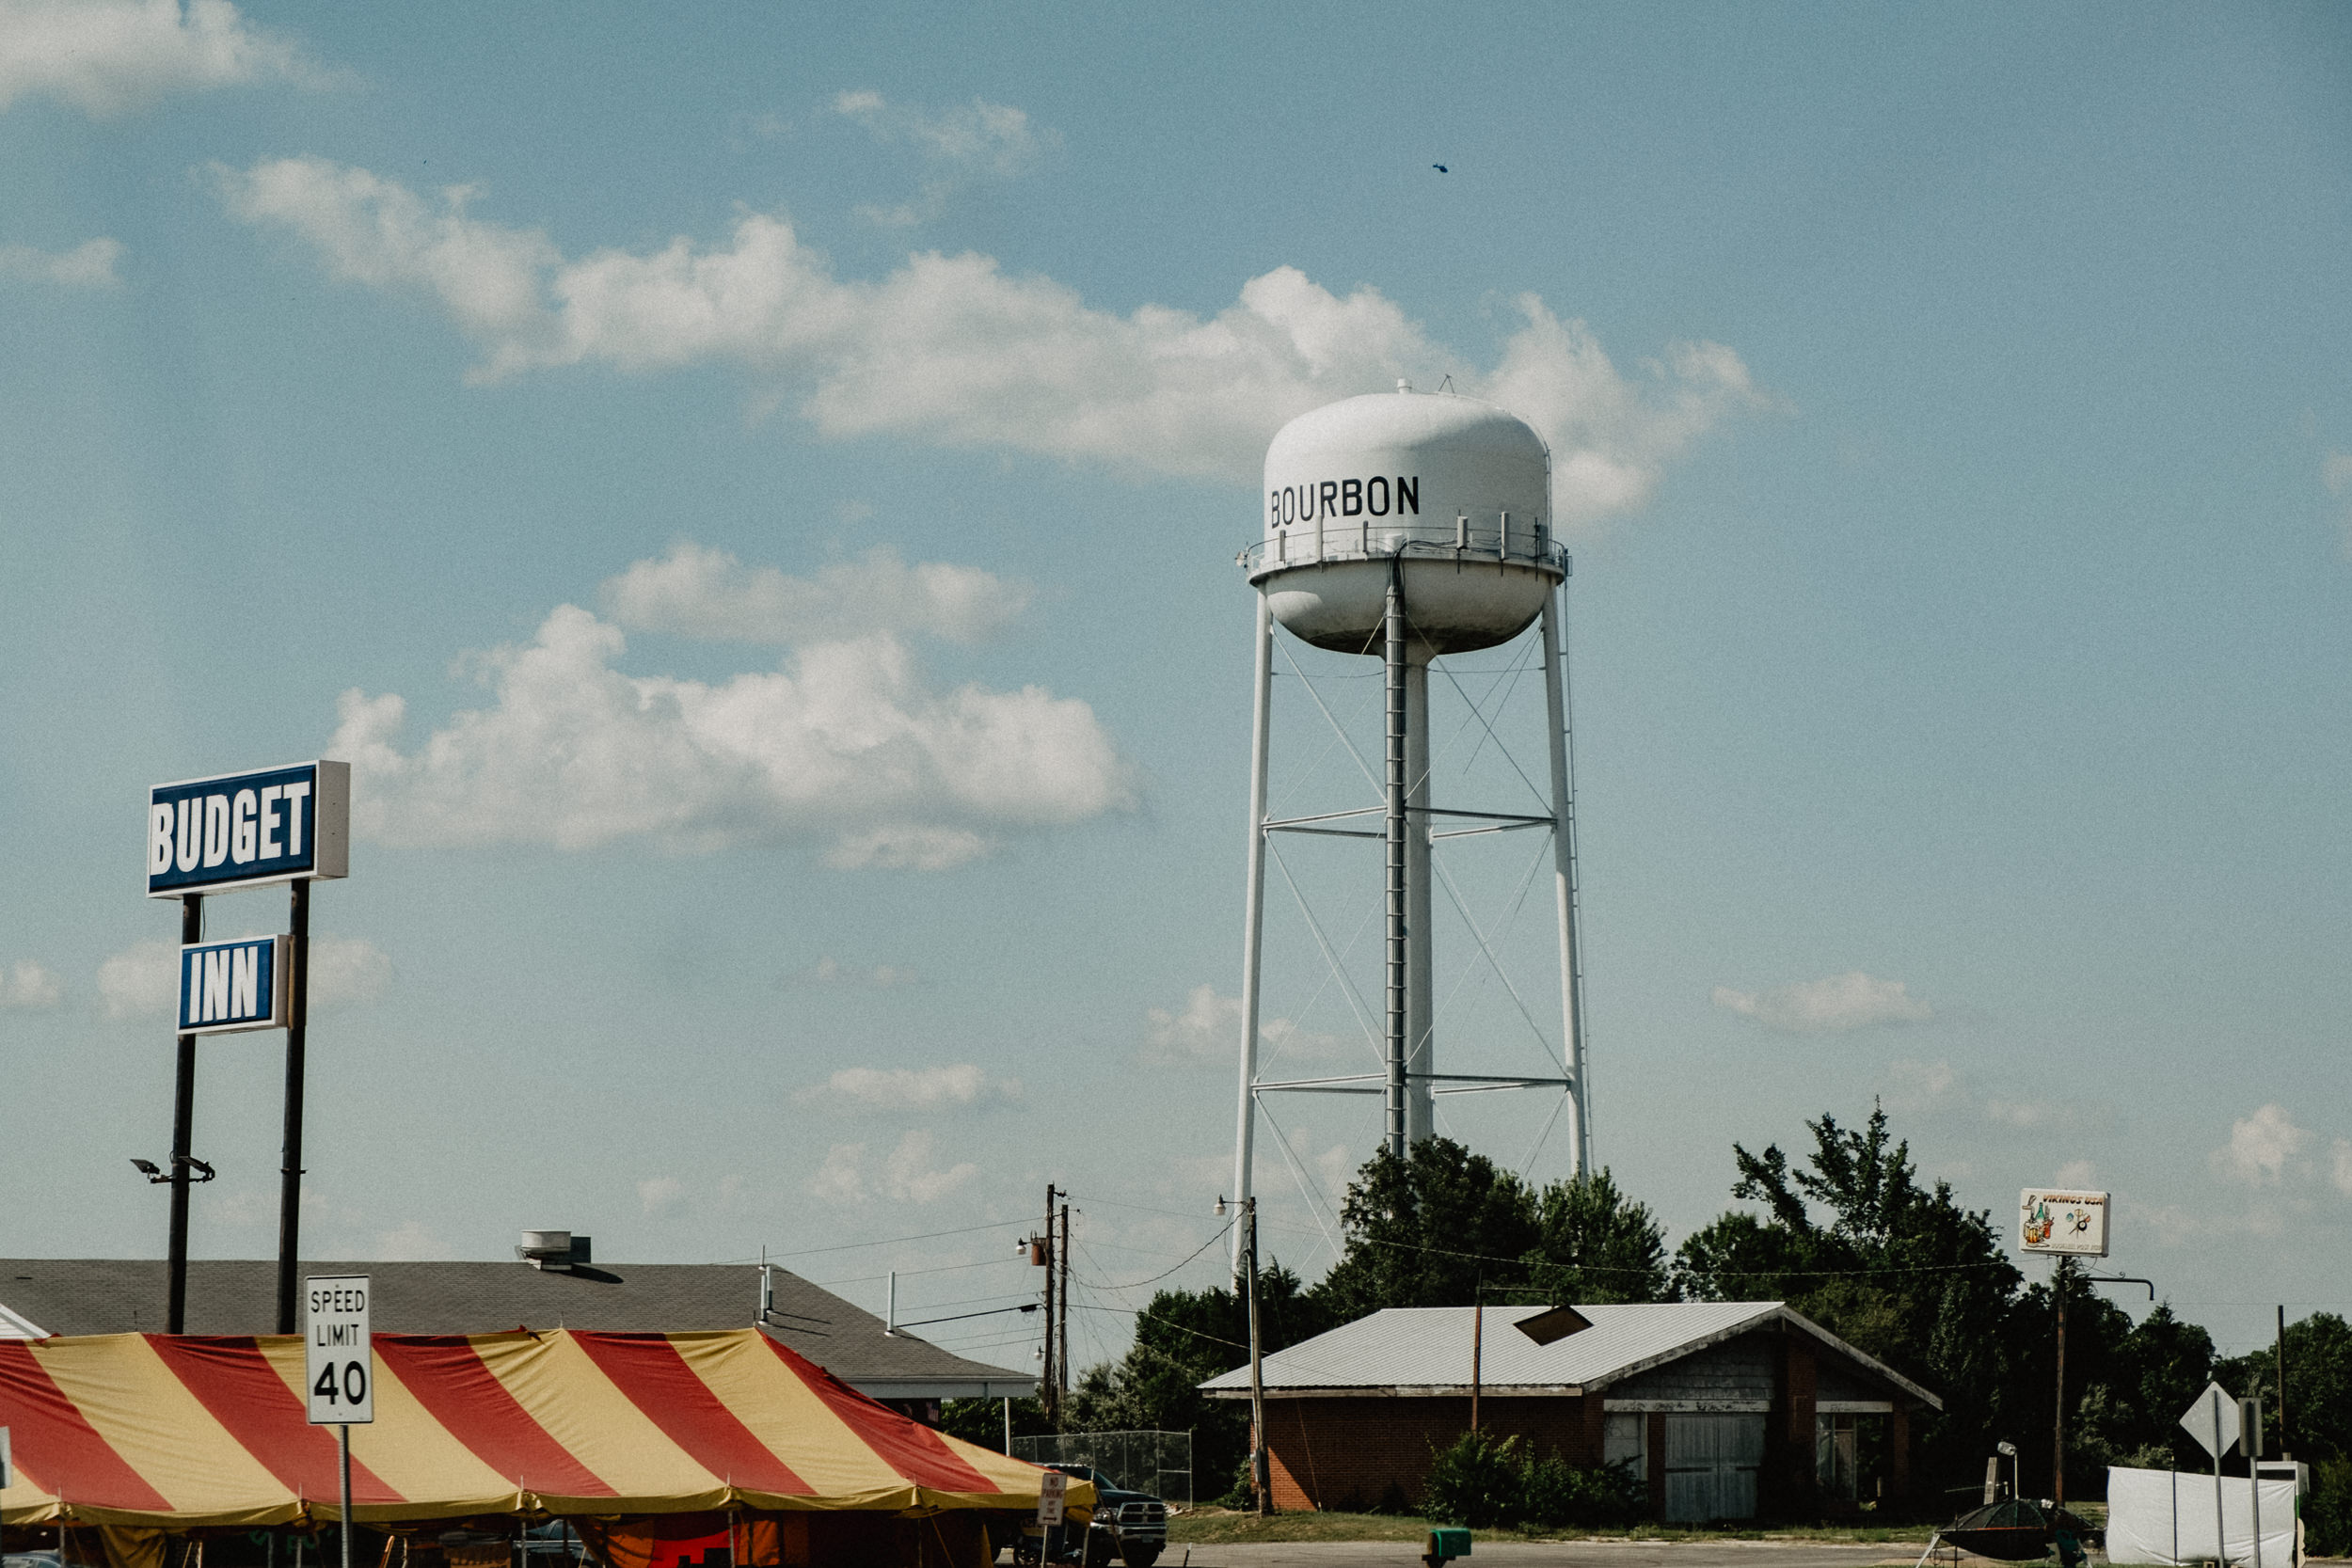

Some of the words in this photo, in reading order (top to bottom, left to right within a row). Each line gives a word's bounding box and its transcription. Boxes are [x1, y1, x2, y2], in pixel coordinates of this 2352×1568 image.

[1272, 476, 1419, 529] BOURBON
[151, 781, 310, 876] BUDGET
[189, 946, 258, 1023] INN
[2042, 1195, 2083, 1204] VIKINGS
[2084, 1196, 2104, 1205] USA
[311, 1291, 365, 1313] SPEED
[317, 1324, 358, 1346] LIMIT
[314, 1361, 366, 1405] 40
[1050, 1477, 1058, 1487] NO
[1042, 1489, 1063, 1498] PARKING
